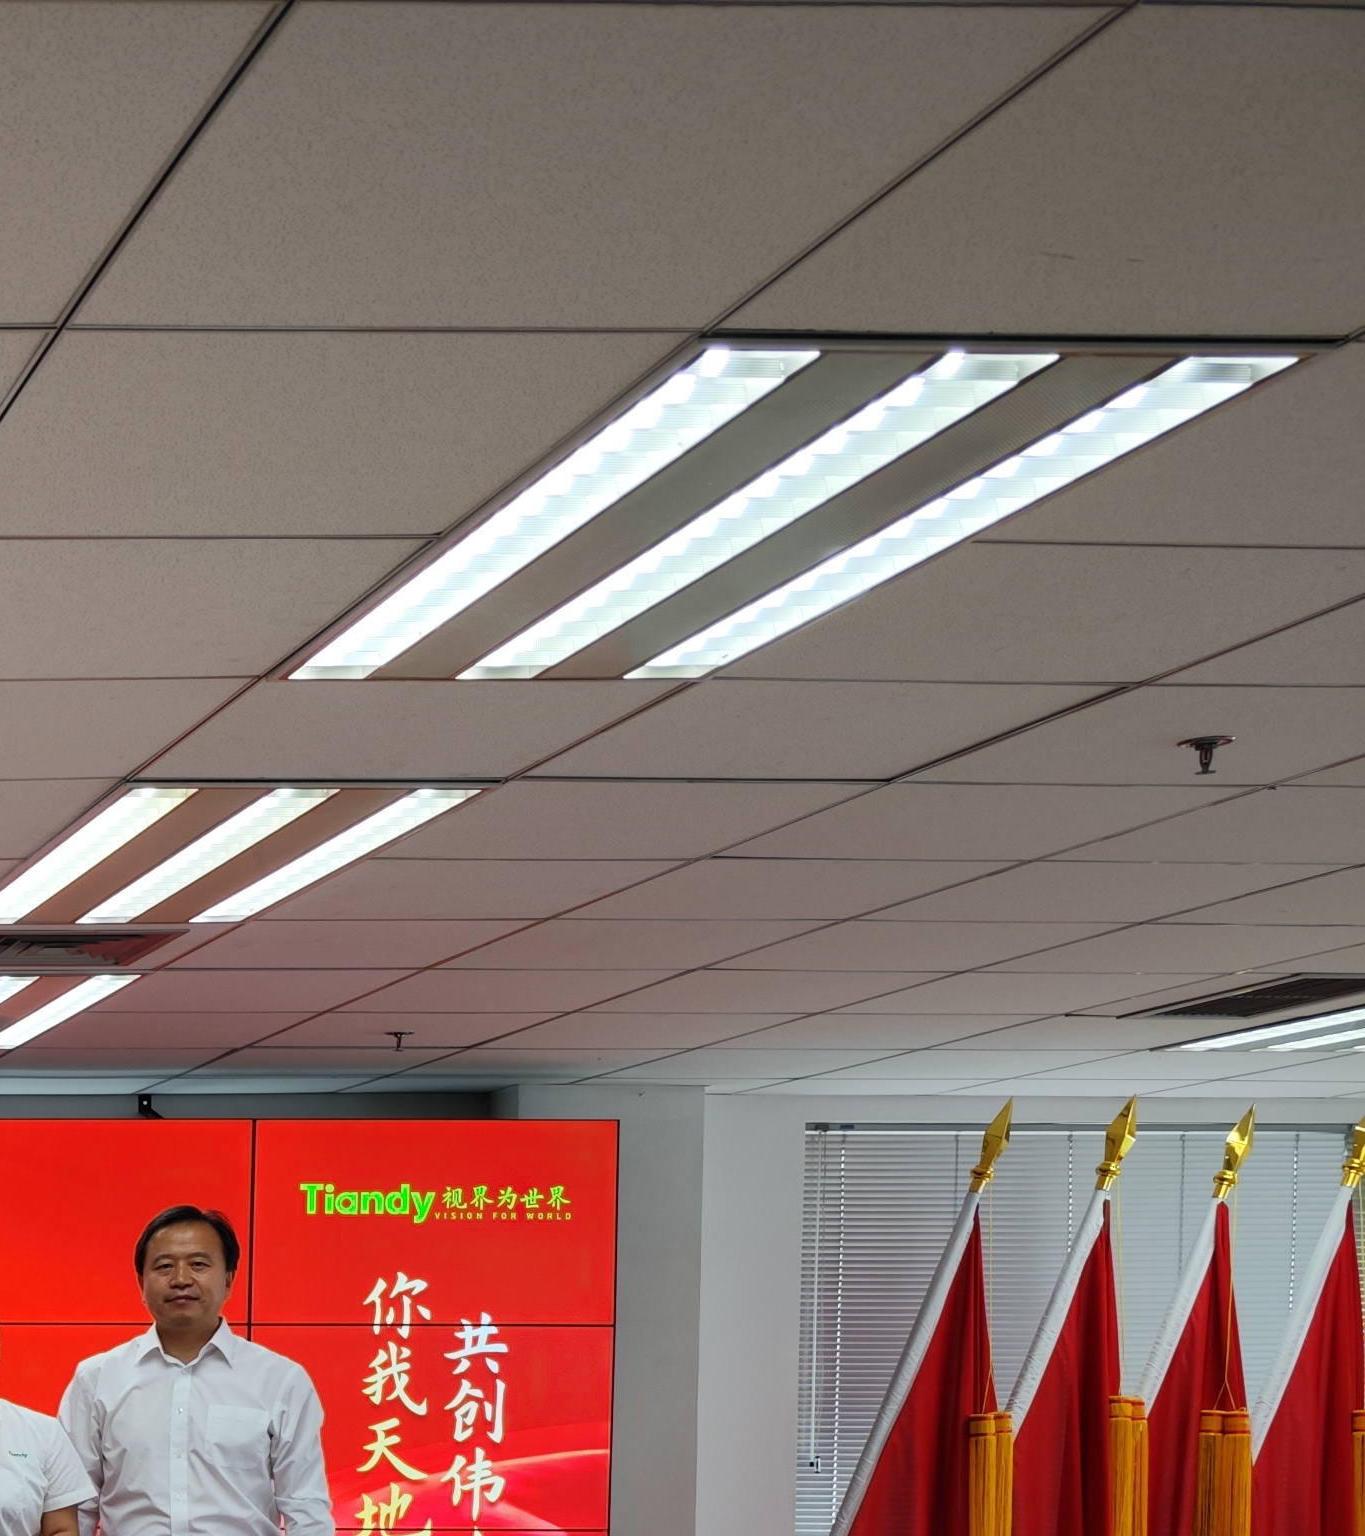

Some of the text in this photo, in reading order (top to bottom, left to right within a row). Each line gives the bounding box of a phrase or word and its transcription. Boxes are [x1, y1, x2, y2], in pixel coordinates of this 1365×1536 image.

[299, 1183, 436, 1224] Tiandy
[441, 1185, 571, 1211] 视界为世界
[434, 1211, 572, 1221] VISION FOR WORLD
